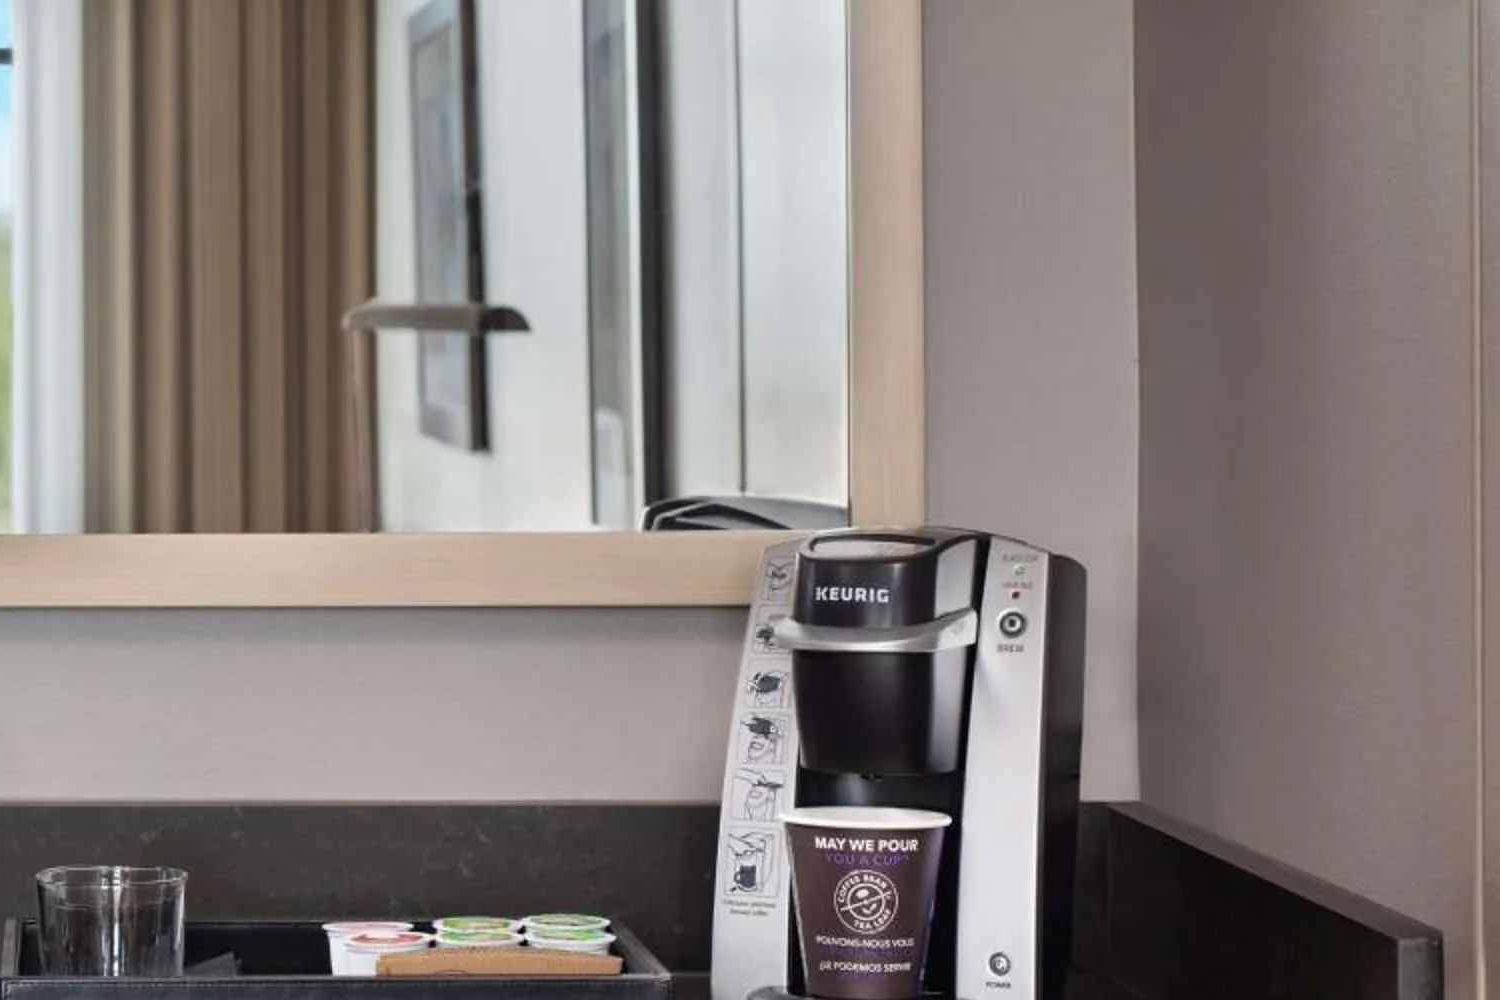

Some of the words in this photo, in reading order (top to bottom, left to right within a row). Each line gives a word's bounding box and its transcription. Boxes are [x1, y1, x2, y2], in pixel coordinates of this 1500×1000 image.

[815, 586, 890, 603] KEURIG
[996, 643, 1024, 653] BREW
[814, 836, 846, 850] MAY
[849, 838, 875, 852] WE
[878, 838, 919, 852] POUR
[824, 853, 855, 865] YOU
